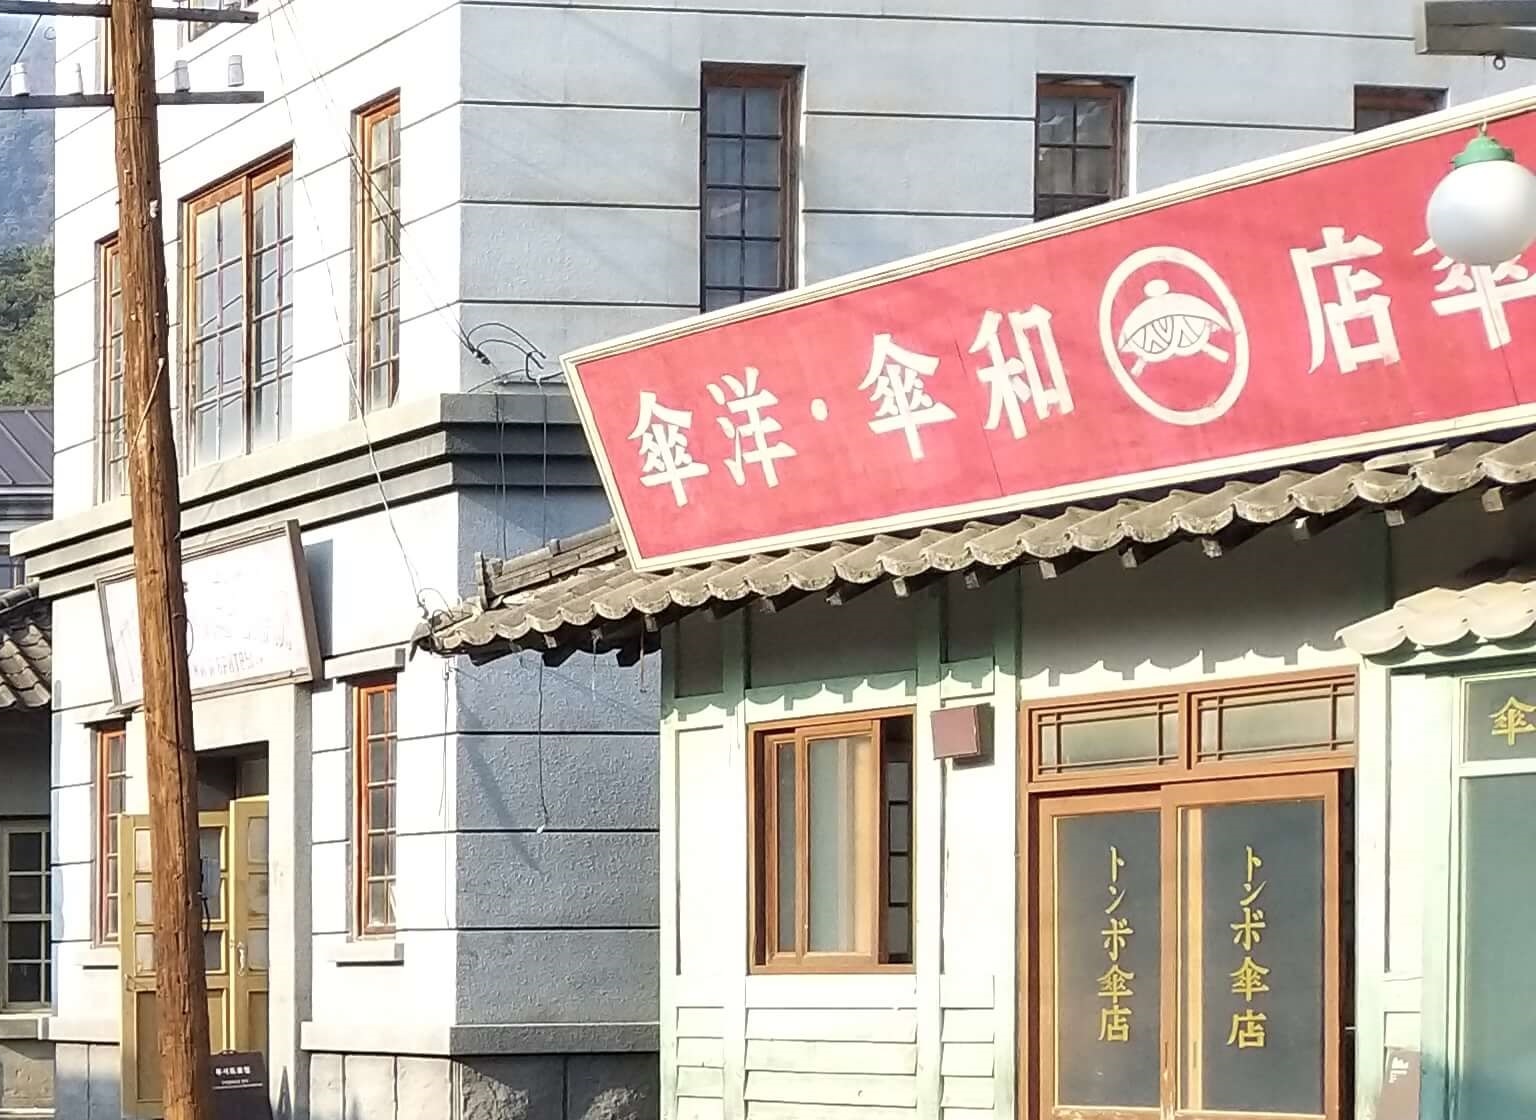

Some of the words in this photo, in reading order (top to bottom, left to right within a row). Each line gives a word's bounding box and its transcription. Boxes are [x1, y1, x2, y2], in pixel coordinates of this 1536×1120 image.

[1096, 845, 1136, 1041] トンボ傘店
[1226, 845, 1271, 1049] トンボ傘店
